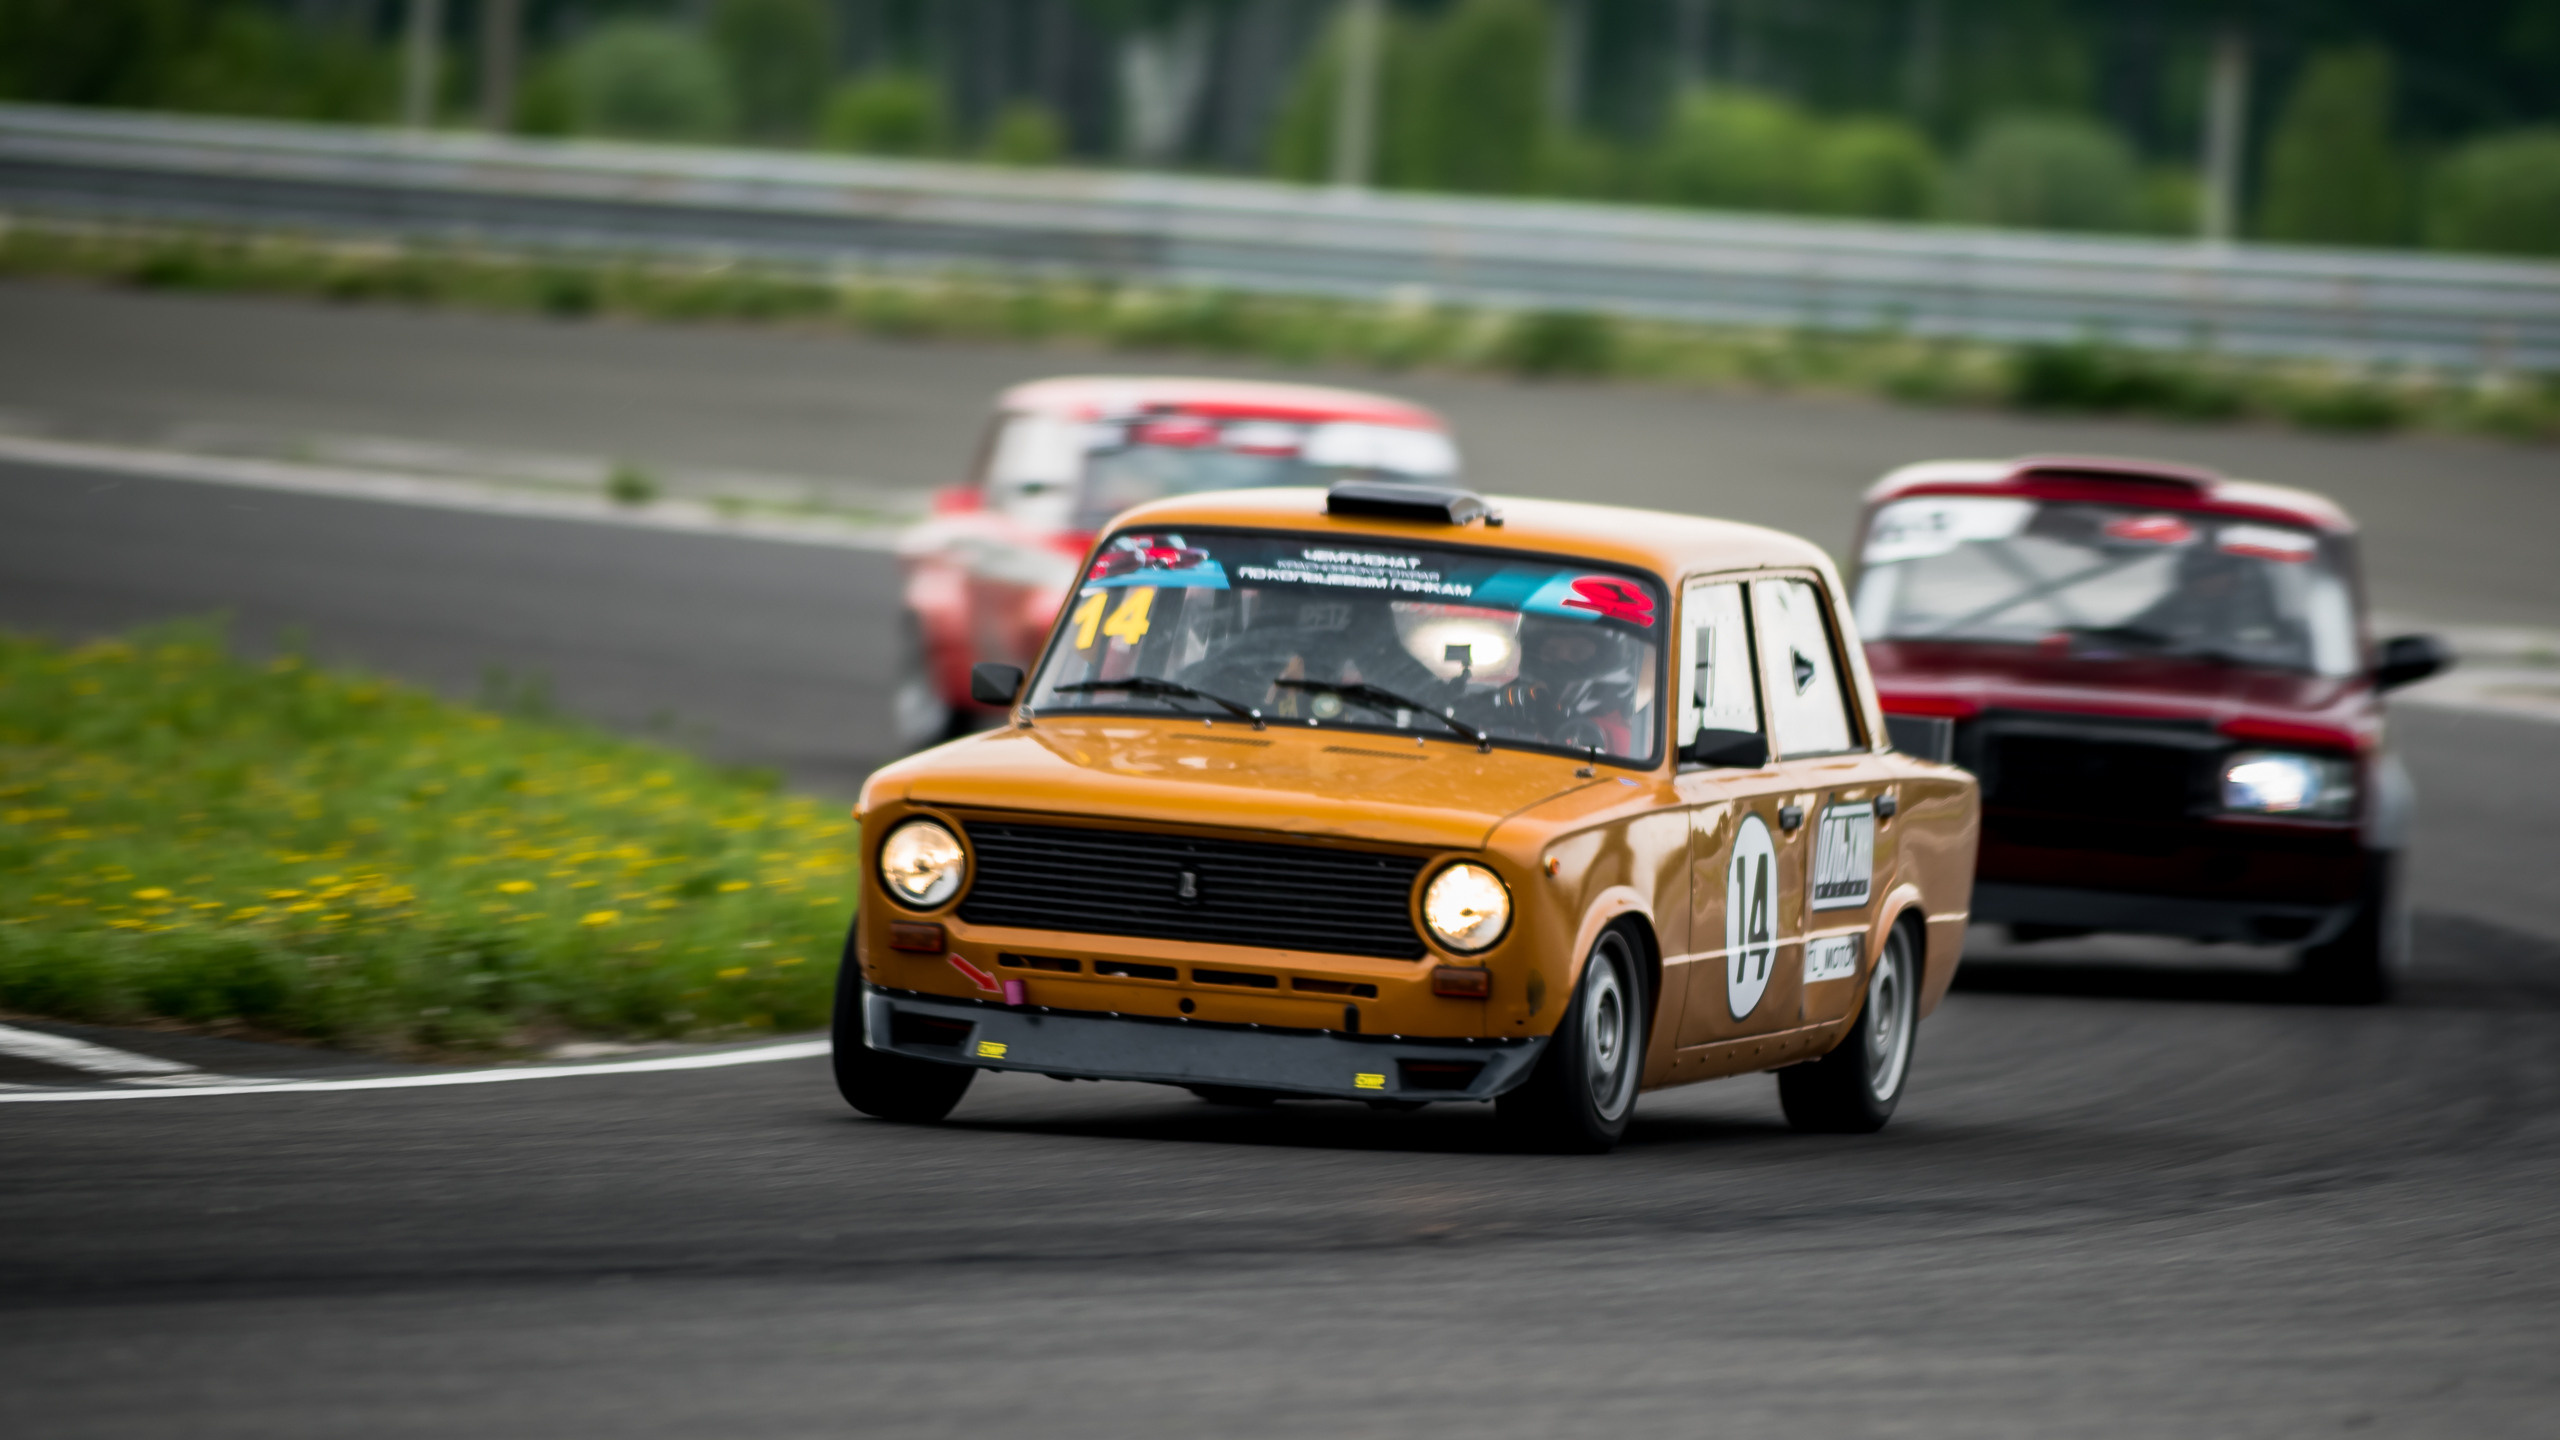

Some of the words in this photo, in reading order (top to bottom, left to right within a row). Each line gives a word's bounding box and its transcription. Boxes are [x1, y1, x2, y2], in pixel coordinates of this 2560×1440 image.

[1239, 566, 1266, 581] ПО
[1267, 568, 1388, 590] КОЛЬЦЕВЫМ
[1391, 577, 1472, 597] ГОНКАМ
[1303, 549, 1421, 570] ЧЕМПИОНАТ
[1074, 586, 1155, 650] 14
[1736, 853, 1769, 984] 14
